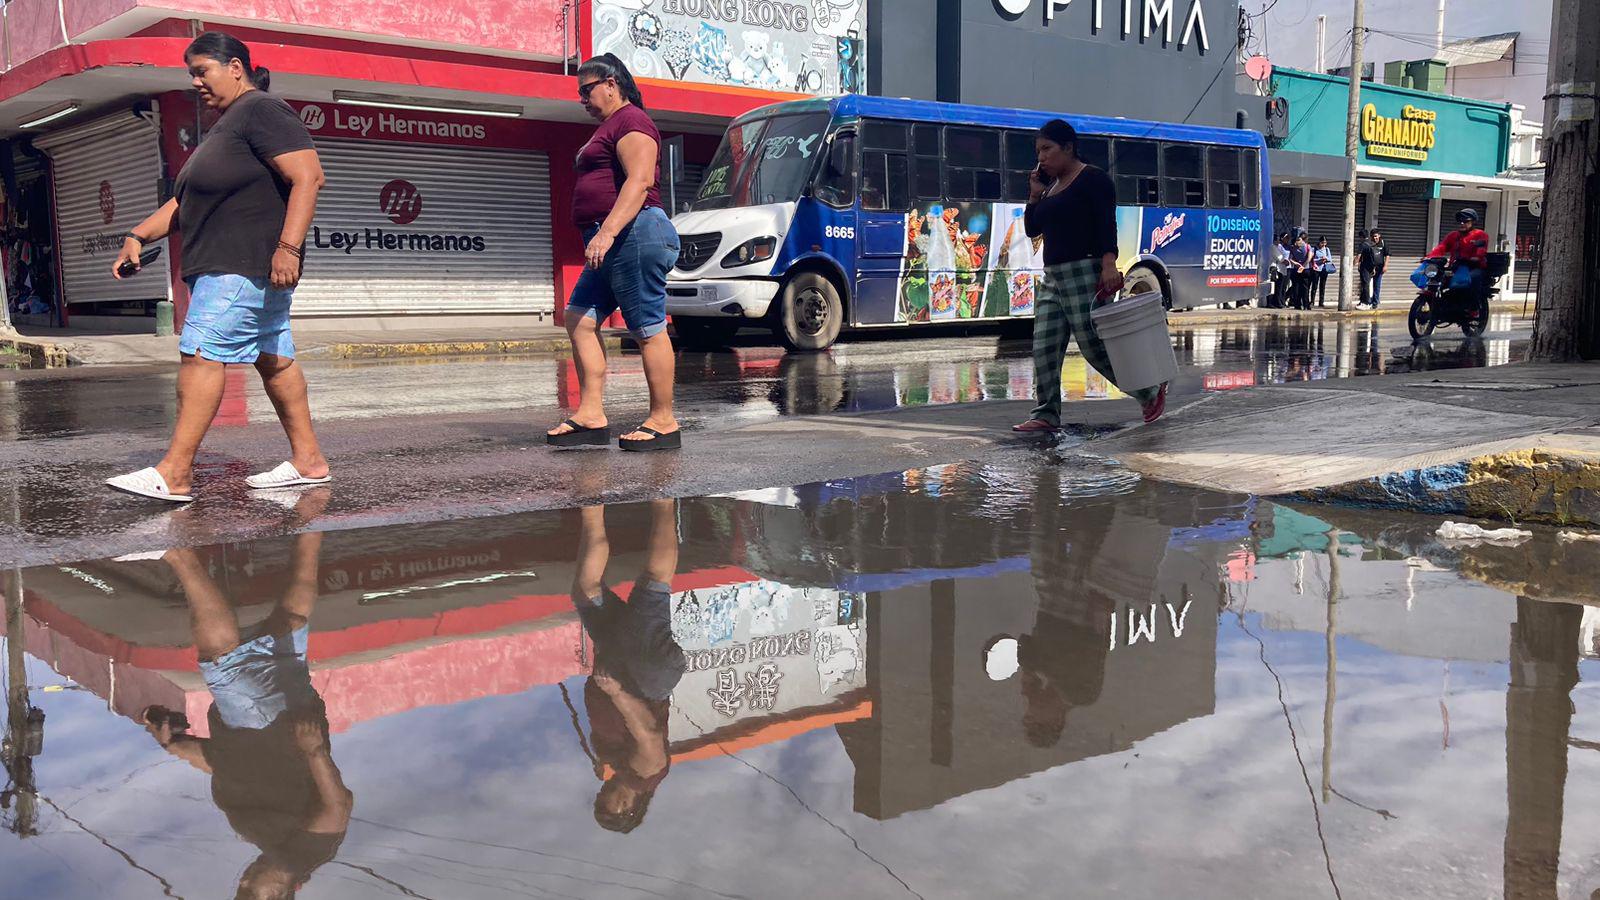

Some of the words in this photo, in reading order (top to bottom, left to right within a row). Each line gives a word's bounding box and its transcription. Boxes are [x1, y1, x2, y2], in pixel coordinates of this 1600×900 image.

[662, 0, 738, 22] HONG
[742, 0, 809, 32] KONG
[997, 0, 1210, 50] TIMA
[1404, 105, 1437, 121] Casa
[334, 109, 373, 137] Ley
[378, 112, 486, 140] Hermanos
[1362, 103, 1436, 149] GRANADOS
[1373, 146, 1388, 155] ROPA
[1393, 149, 1426, 160] UNIFORMES
[825, 225, 855, 239] 8665
[1207, 215, 1220, 233] 10
[1221, 216, 1261, 232] DISEÑOS
[313, 226, 359, 255] Ley
[364, 228, 486, 252] Hermanos
[1210, 235, 1254, 253] EDICIÓN
[1203, 254, 1258, 270] ESPECIAL
[1210, 277, 1219, 285] POR
[1220, 277, 1237, 285] TIEMPO
[1237, 276, 1257, 284] LIMITADO
